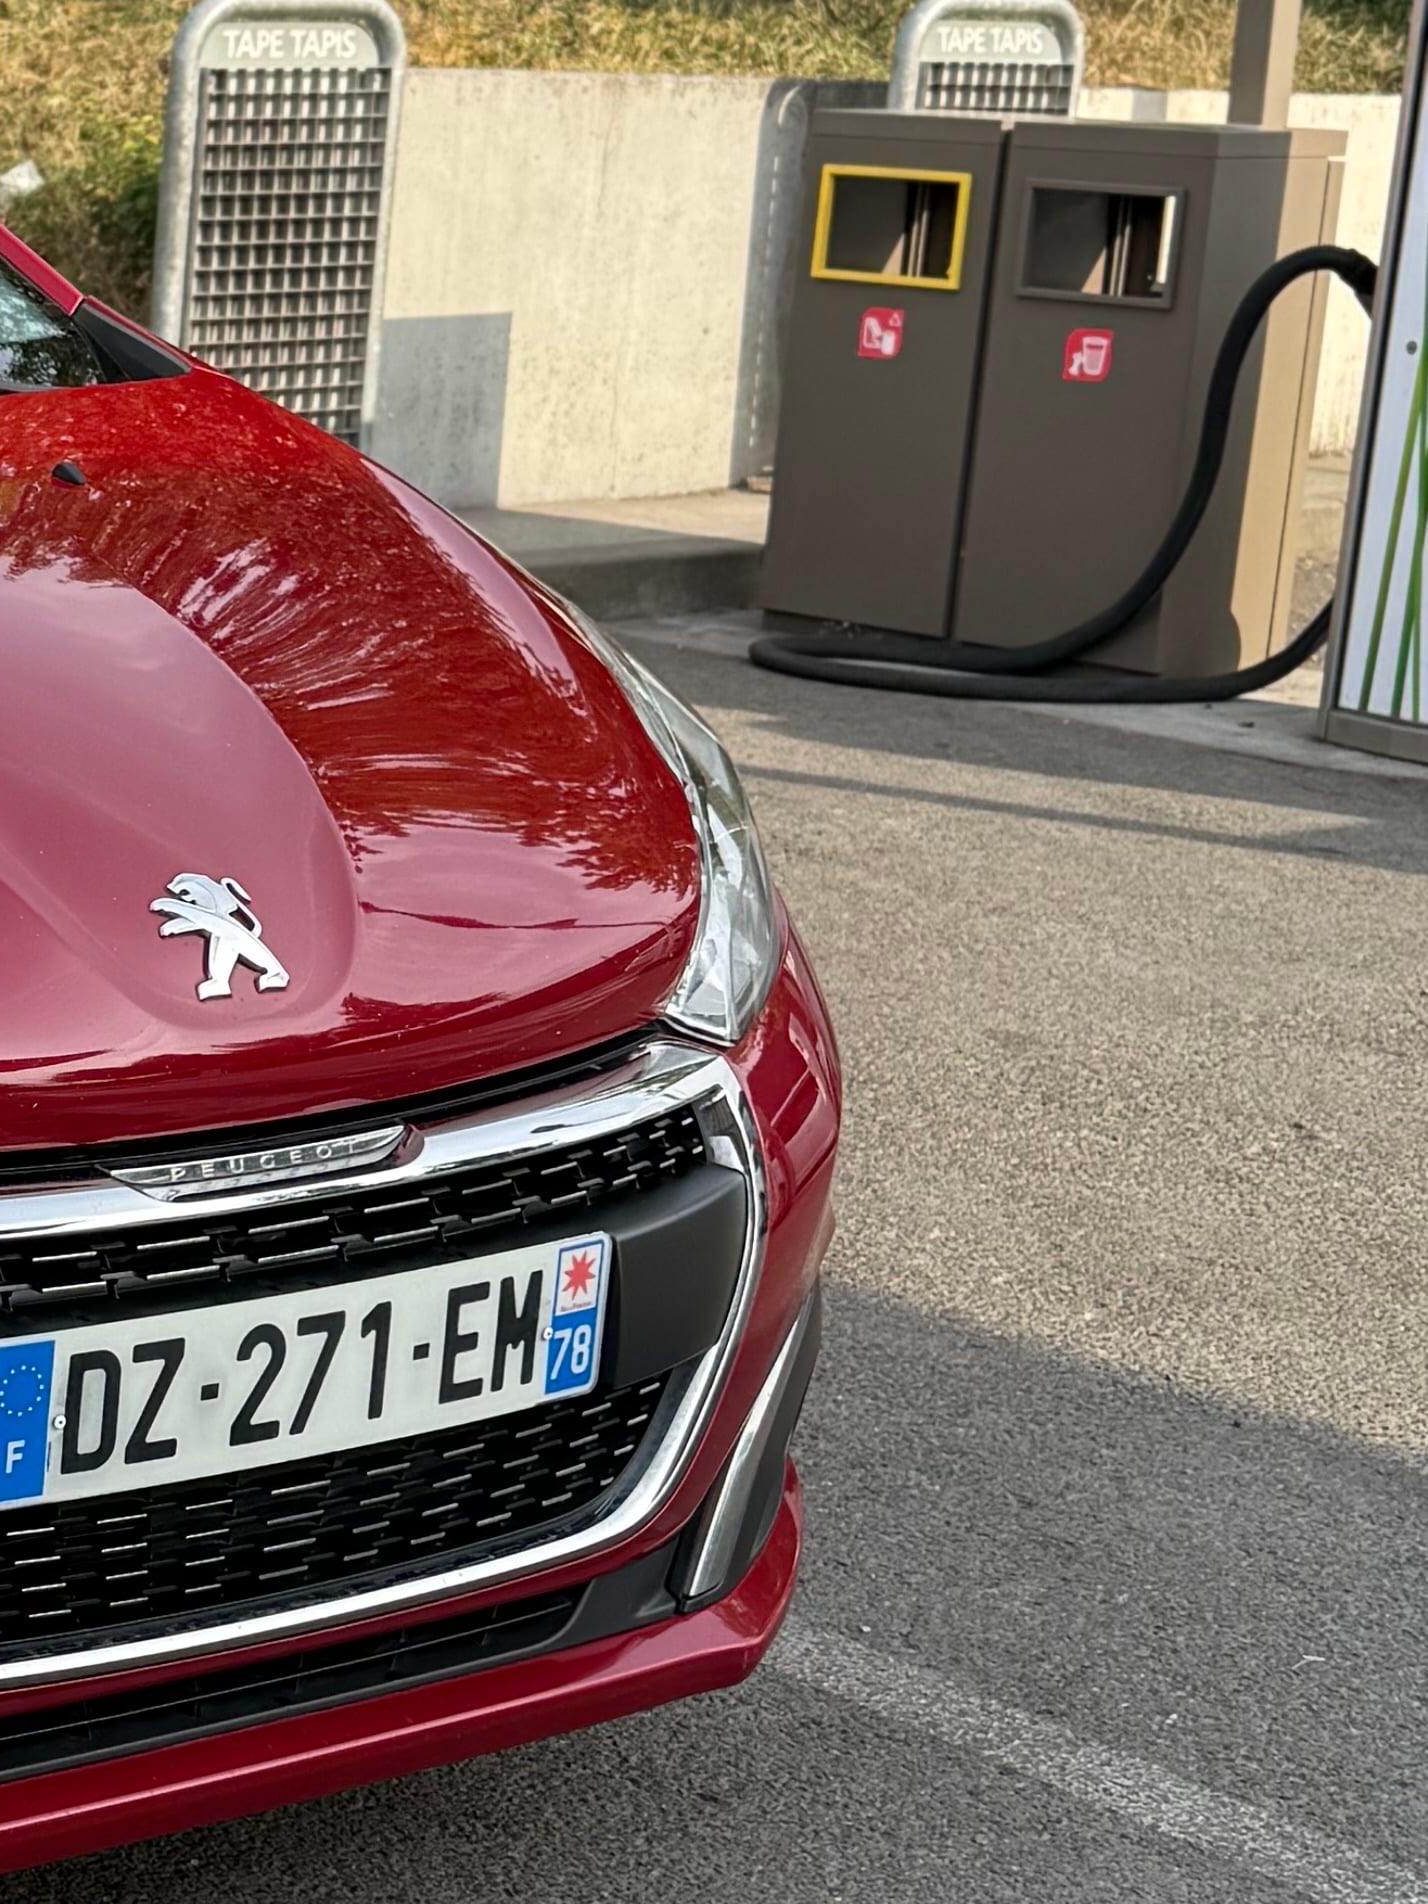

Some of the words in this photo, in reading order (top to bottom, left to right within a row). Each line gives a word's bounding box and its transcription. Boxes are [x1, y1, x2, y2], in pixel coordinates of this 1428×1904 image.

[937, 25, 987, 53] TAPE
[989, 26, 1043, 54] TAPIS
[169, 1139, 361, 1182] PEUGEOT
[60, 1269, 544, 1475] DZ-271-EM
[550, 1323, 593, 1381] 78
[4, 1439, 26, 1474] F
